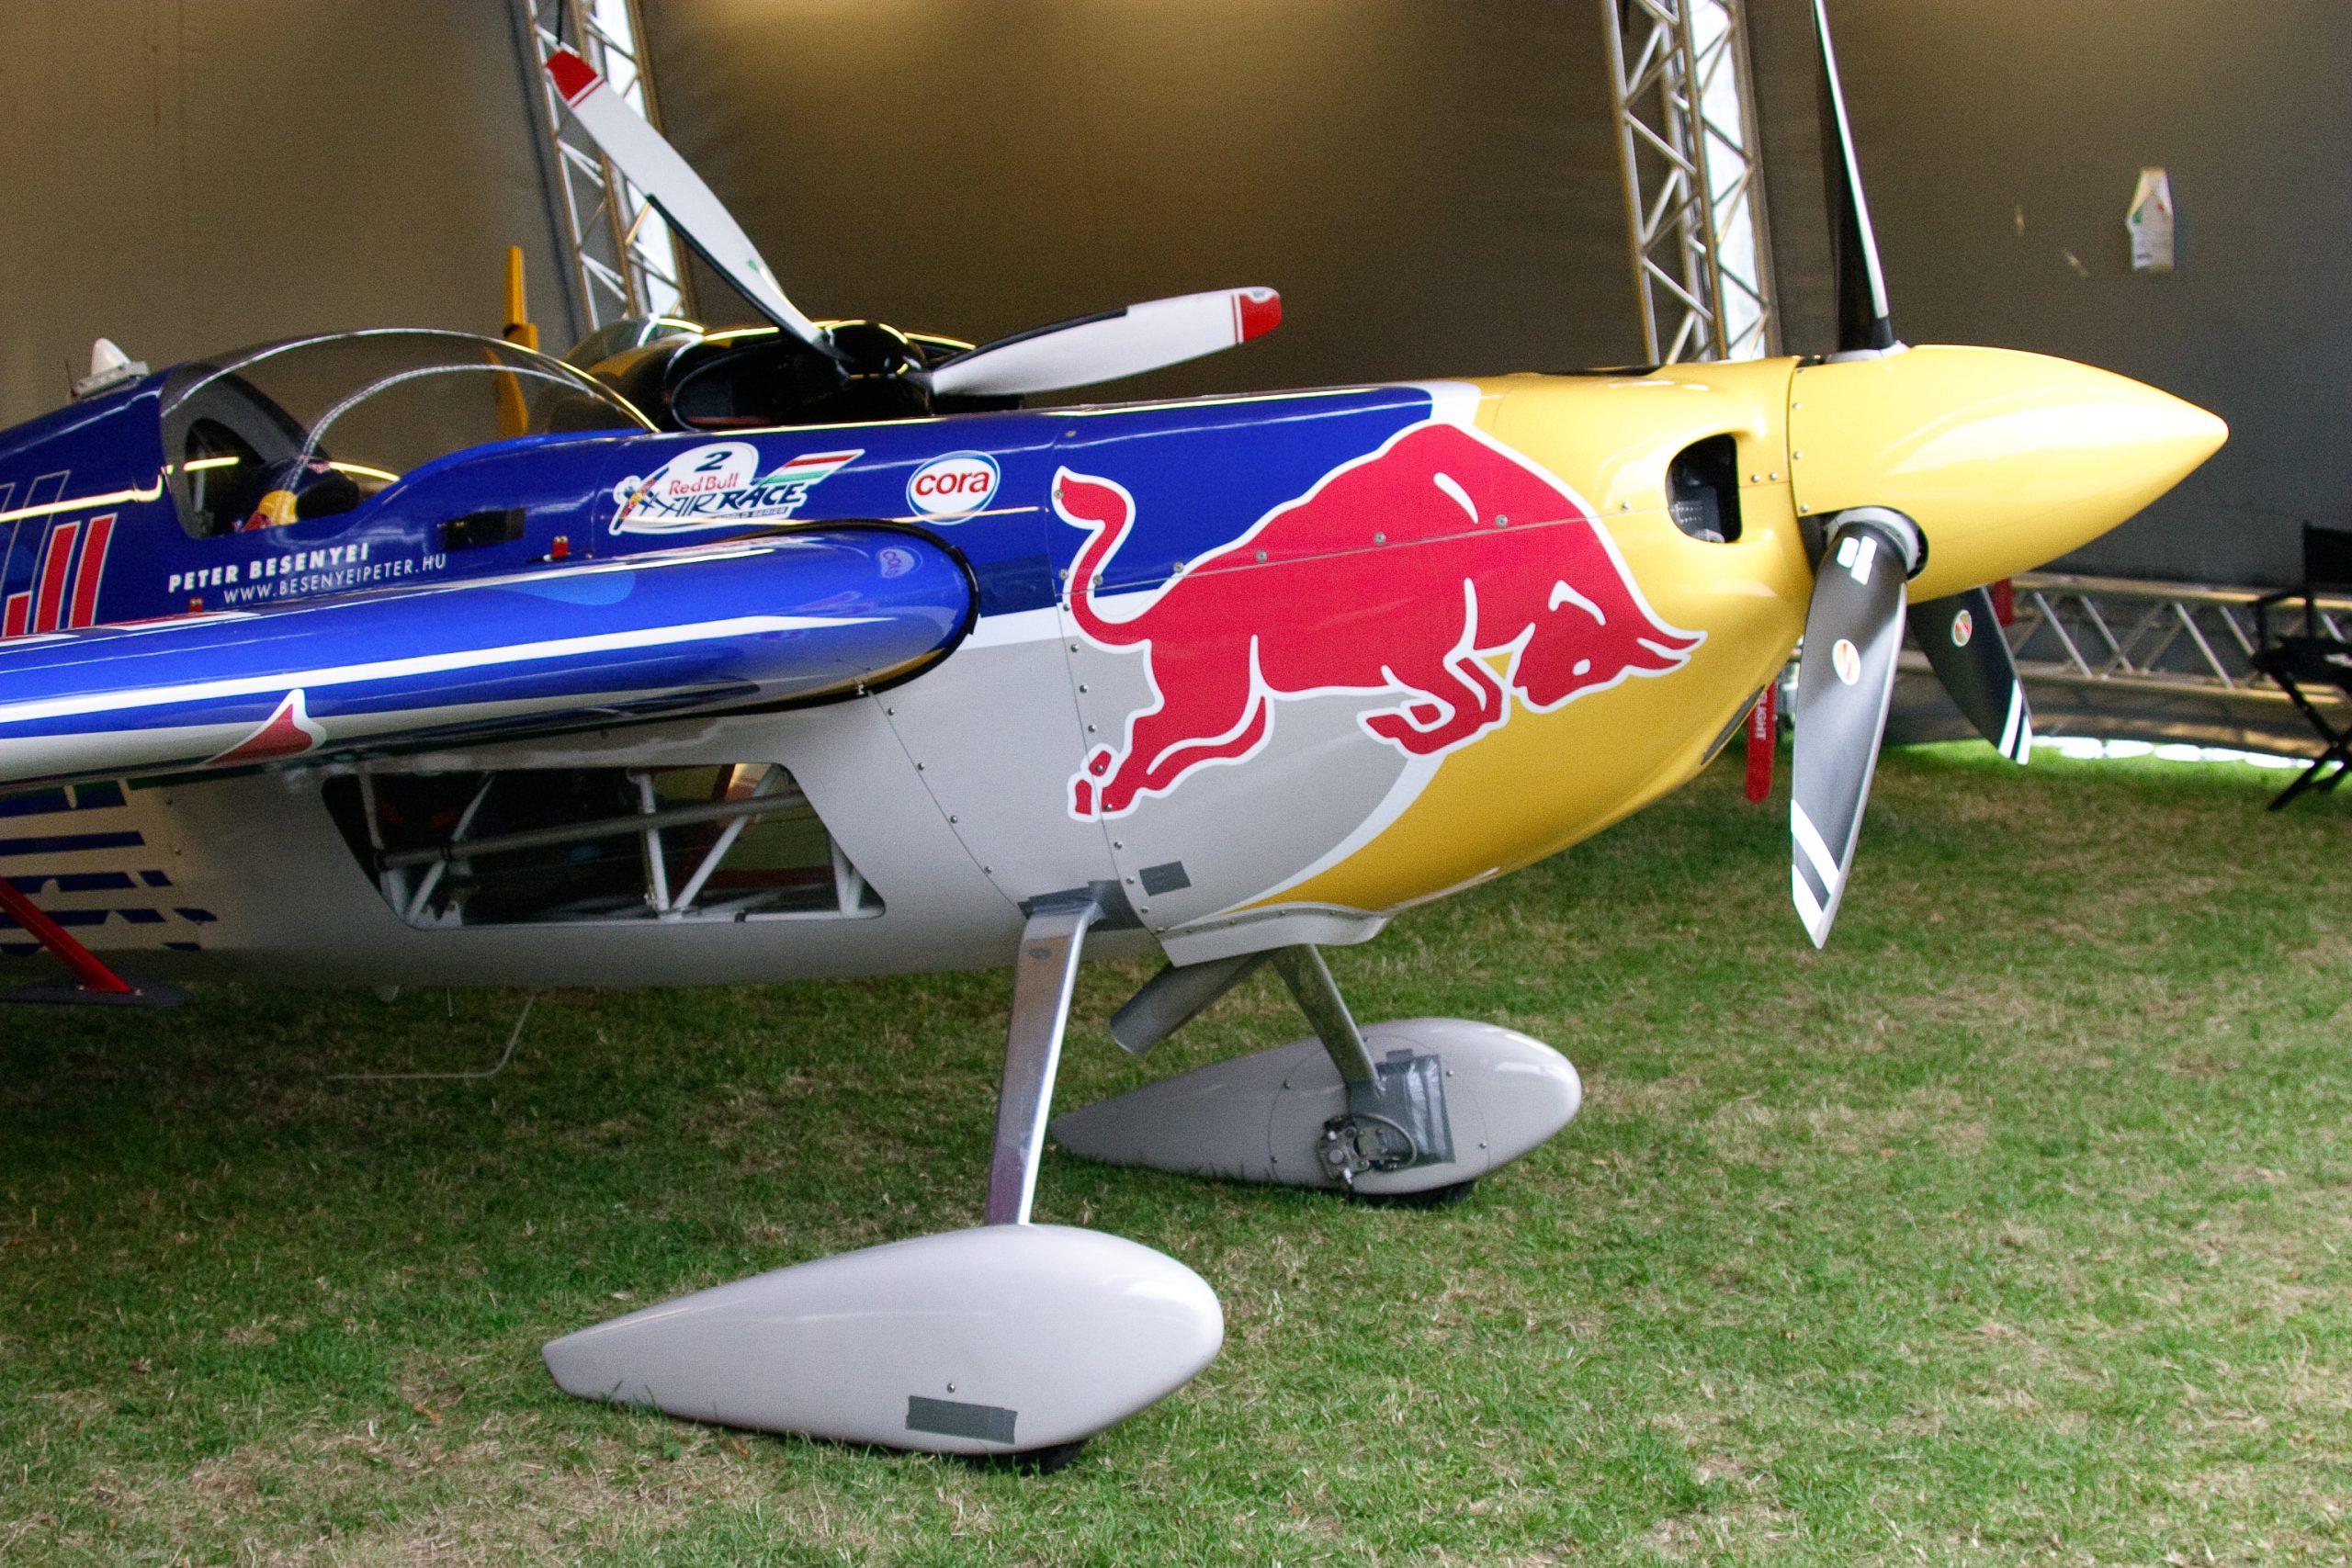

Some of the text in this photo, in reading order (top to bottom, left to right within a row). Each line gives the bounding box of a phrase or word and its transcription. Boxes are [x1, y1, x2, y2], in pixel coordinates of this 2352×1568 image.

[695, 451, 732, 472] 2
[669, 472, 739, 495] Red Bull
[915, 471, 989, 495] cora
[716, 482, 805, 511] RACE
[168, 543, 368, 592] PETER BESENYEI
[224, 553, 447, 604] WWW.BESENYEIPETER.HU
